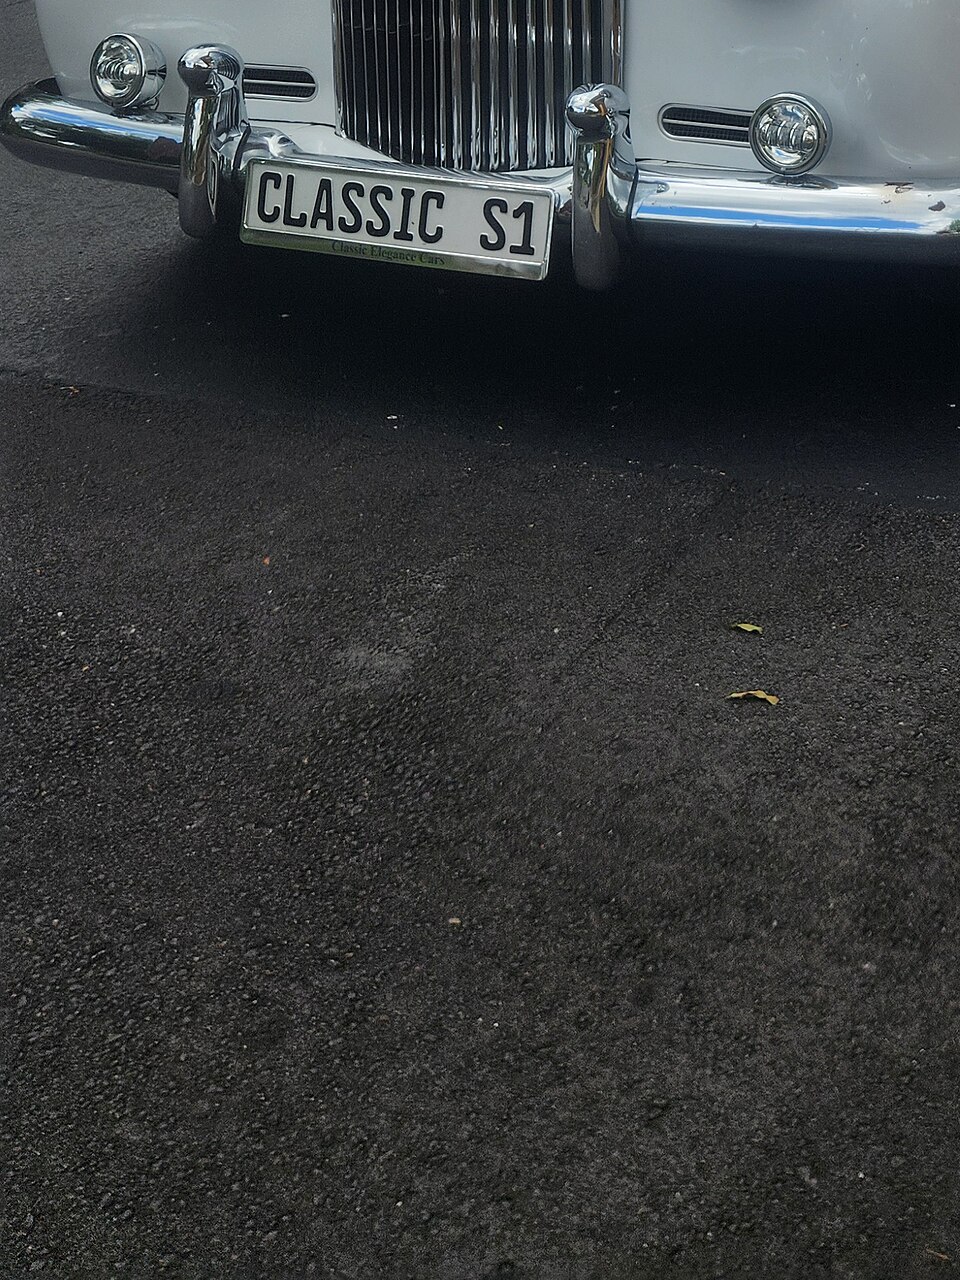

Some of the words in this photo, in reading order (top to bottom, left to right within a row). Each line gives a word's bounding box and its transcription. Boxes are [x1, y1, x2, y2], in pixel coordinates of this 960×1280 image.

[257, 171, 445, 244] CLASSIC
[479, 198, 535, 256] S1
[331, 241, 368, 256] Classic
[370, 245, 417, 261] Elegance
[419, 254, 446, 265] Cars
